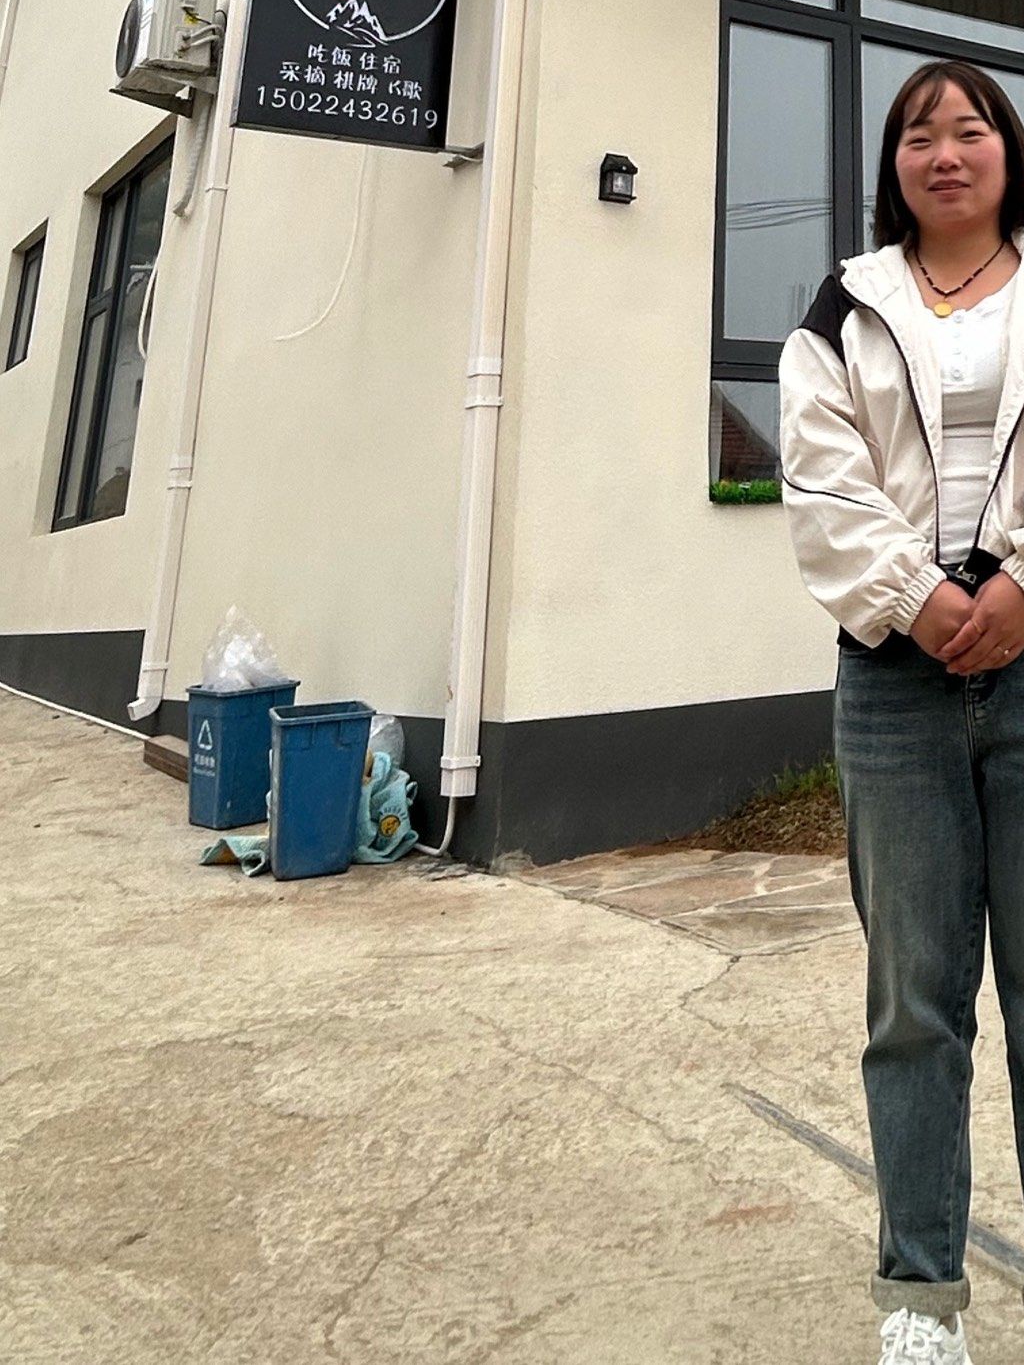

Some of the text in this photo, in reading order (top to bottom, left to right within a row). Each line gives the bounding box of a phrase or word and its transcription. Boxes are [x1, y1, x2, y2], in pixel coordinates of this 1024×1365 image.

[280, 61, 423, 101] 采摘 棋牌 K歌
[359, 52, 401, 74] 住宿
[256, 85, 438, 128] 15022432619
